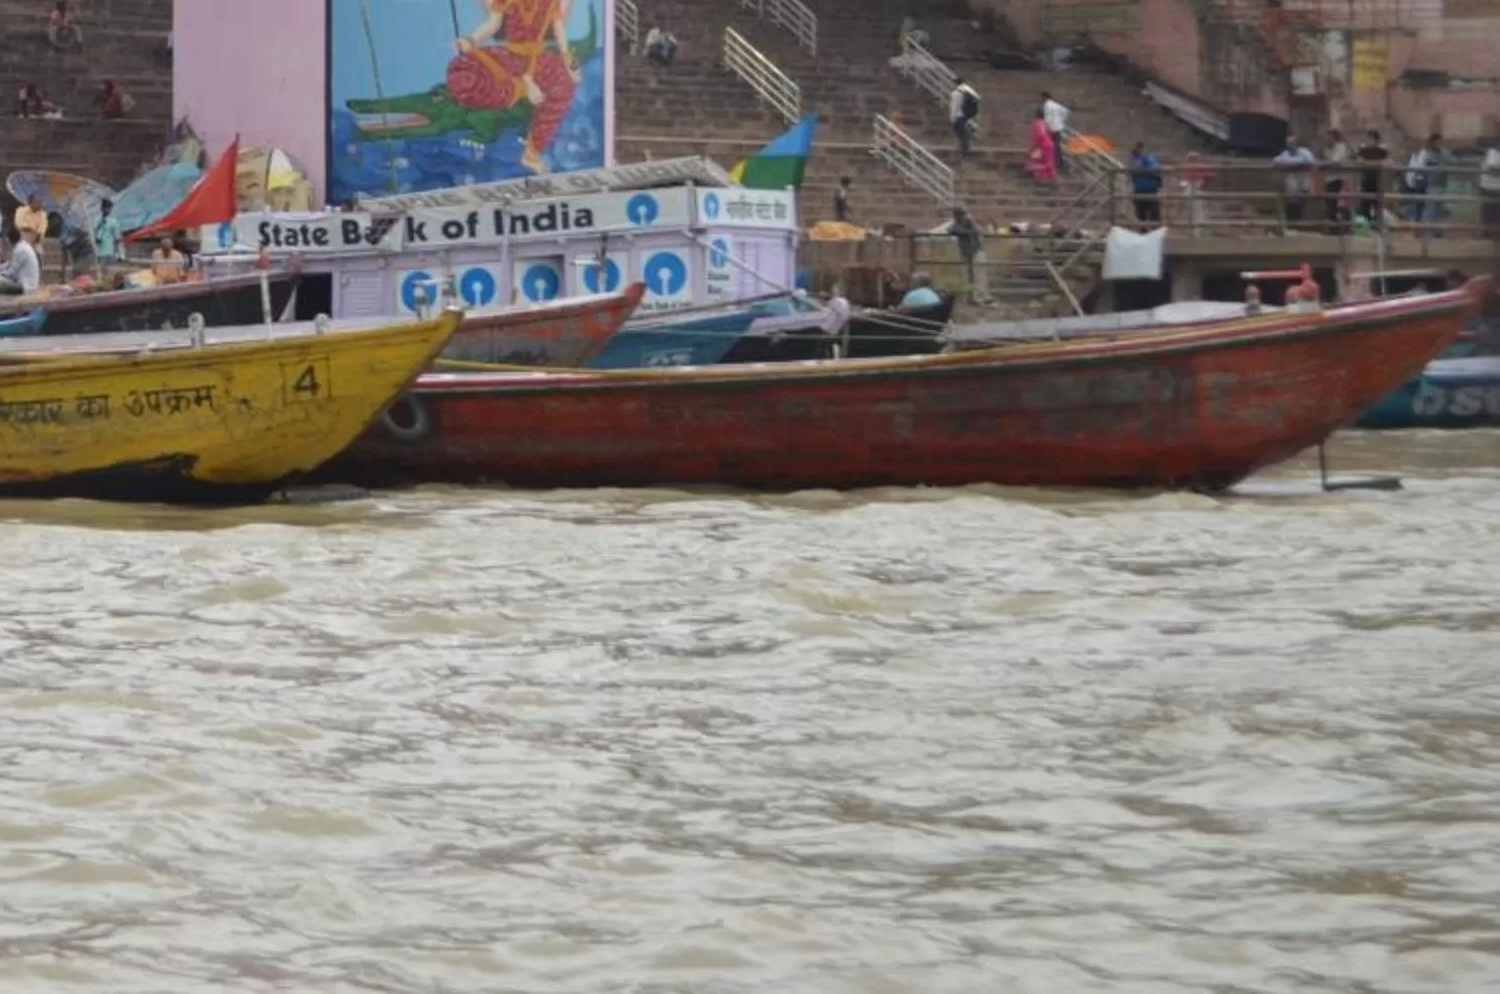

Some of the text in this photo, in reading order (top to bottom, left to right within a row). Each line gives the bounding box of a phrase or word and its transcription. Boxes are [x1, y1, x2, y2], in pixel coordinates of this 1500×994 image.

[258, 220, 330, 248] State
[441, 210, 479, 241] of
[493, 203, 594, 236] India
[292, 364, 322, 399] 4
